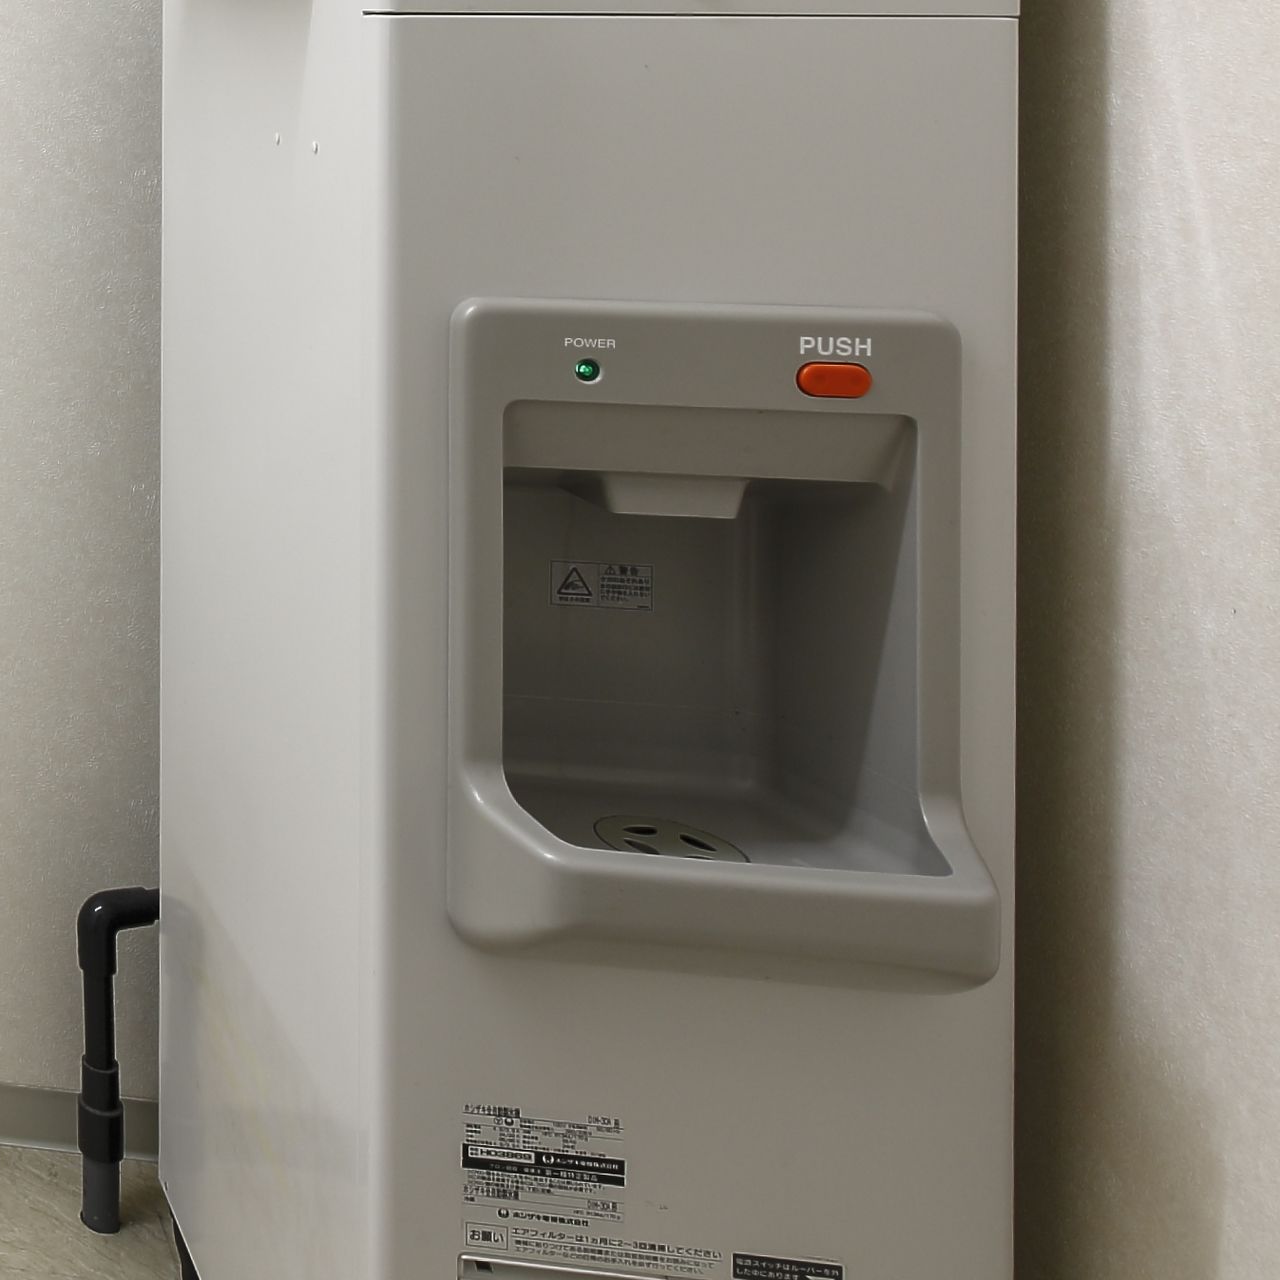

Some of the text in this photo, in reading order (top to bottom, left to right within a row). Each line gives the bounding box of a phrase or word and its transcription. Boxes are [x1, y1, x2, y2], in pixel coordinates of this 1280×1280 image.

[564, 337, 616, 349] POWER
[799, 336, 872, 356] PUSH
[469, 1229, 504, 1243] お願い
